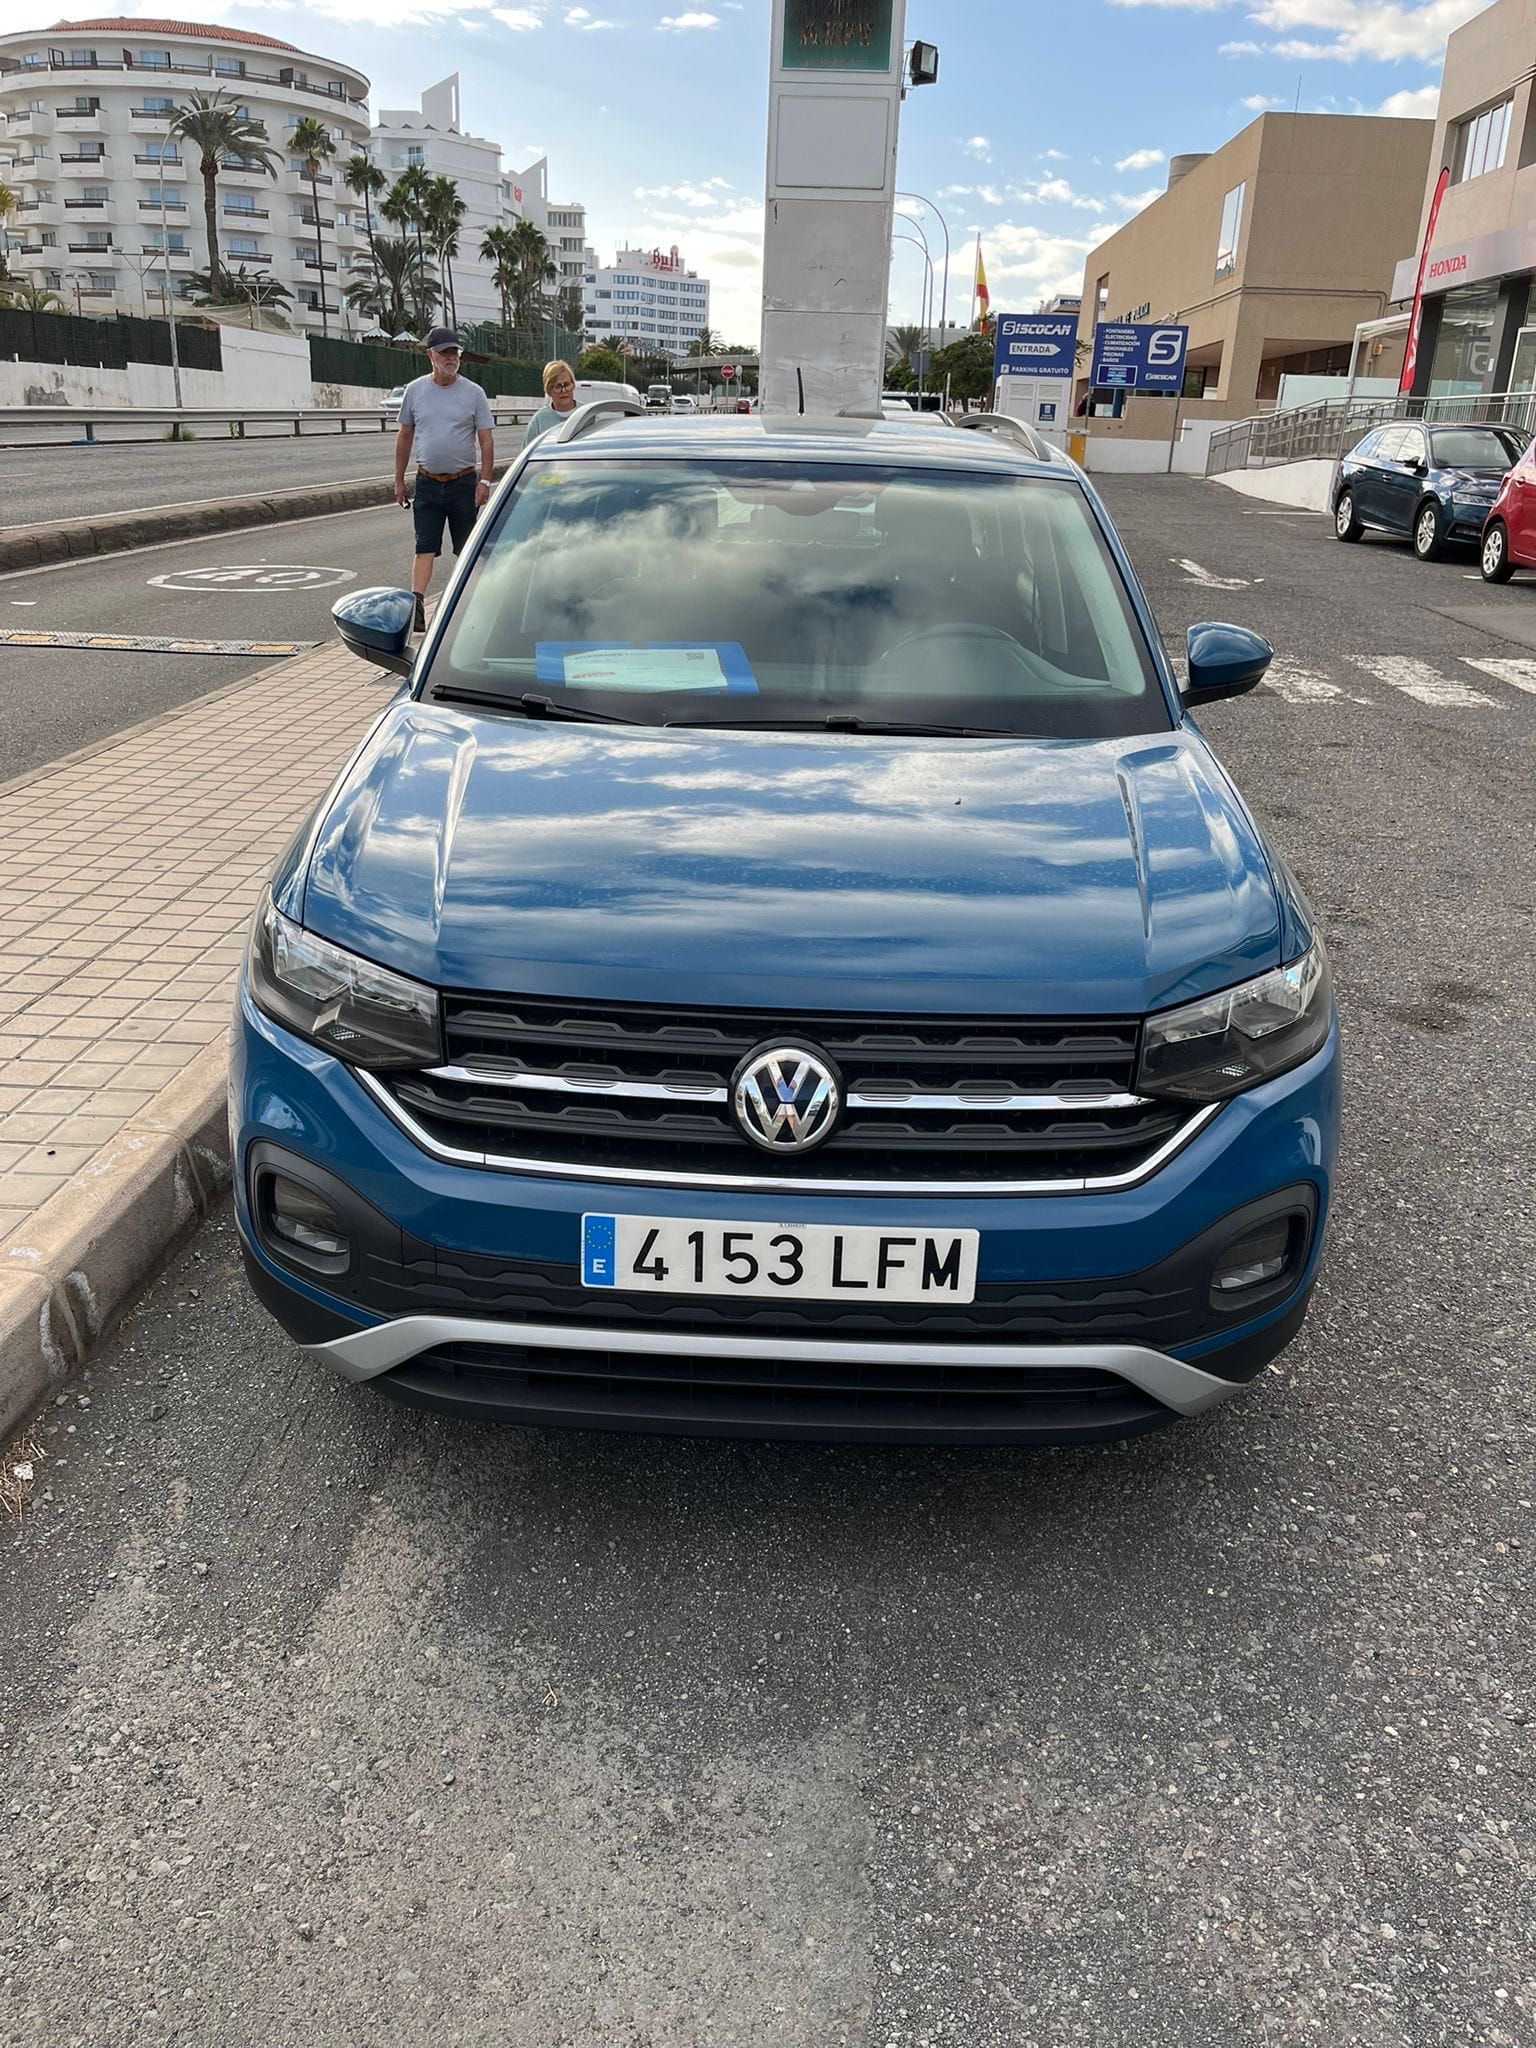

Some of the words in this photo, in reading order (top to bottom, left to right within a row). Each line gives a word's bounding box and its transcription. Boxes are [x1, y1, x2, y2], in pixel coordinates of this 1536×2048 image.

[653, 247, 680, 267] Bull
[1429, 255, 1467, 279] HONDA
[1012, 345, 1051, 353] ENTRADA
[740, 1052, 834, 1149] VW
[592, 1258, 606, 1275] E
[632, 1228, 804, 1286] 4153
[831, 1235, 962, 1291] LFM
